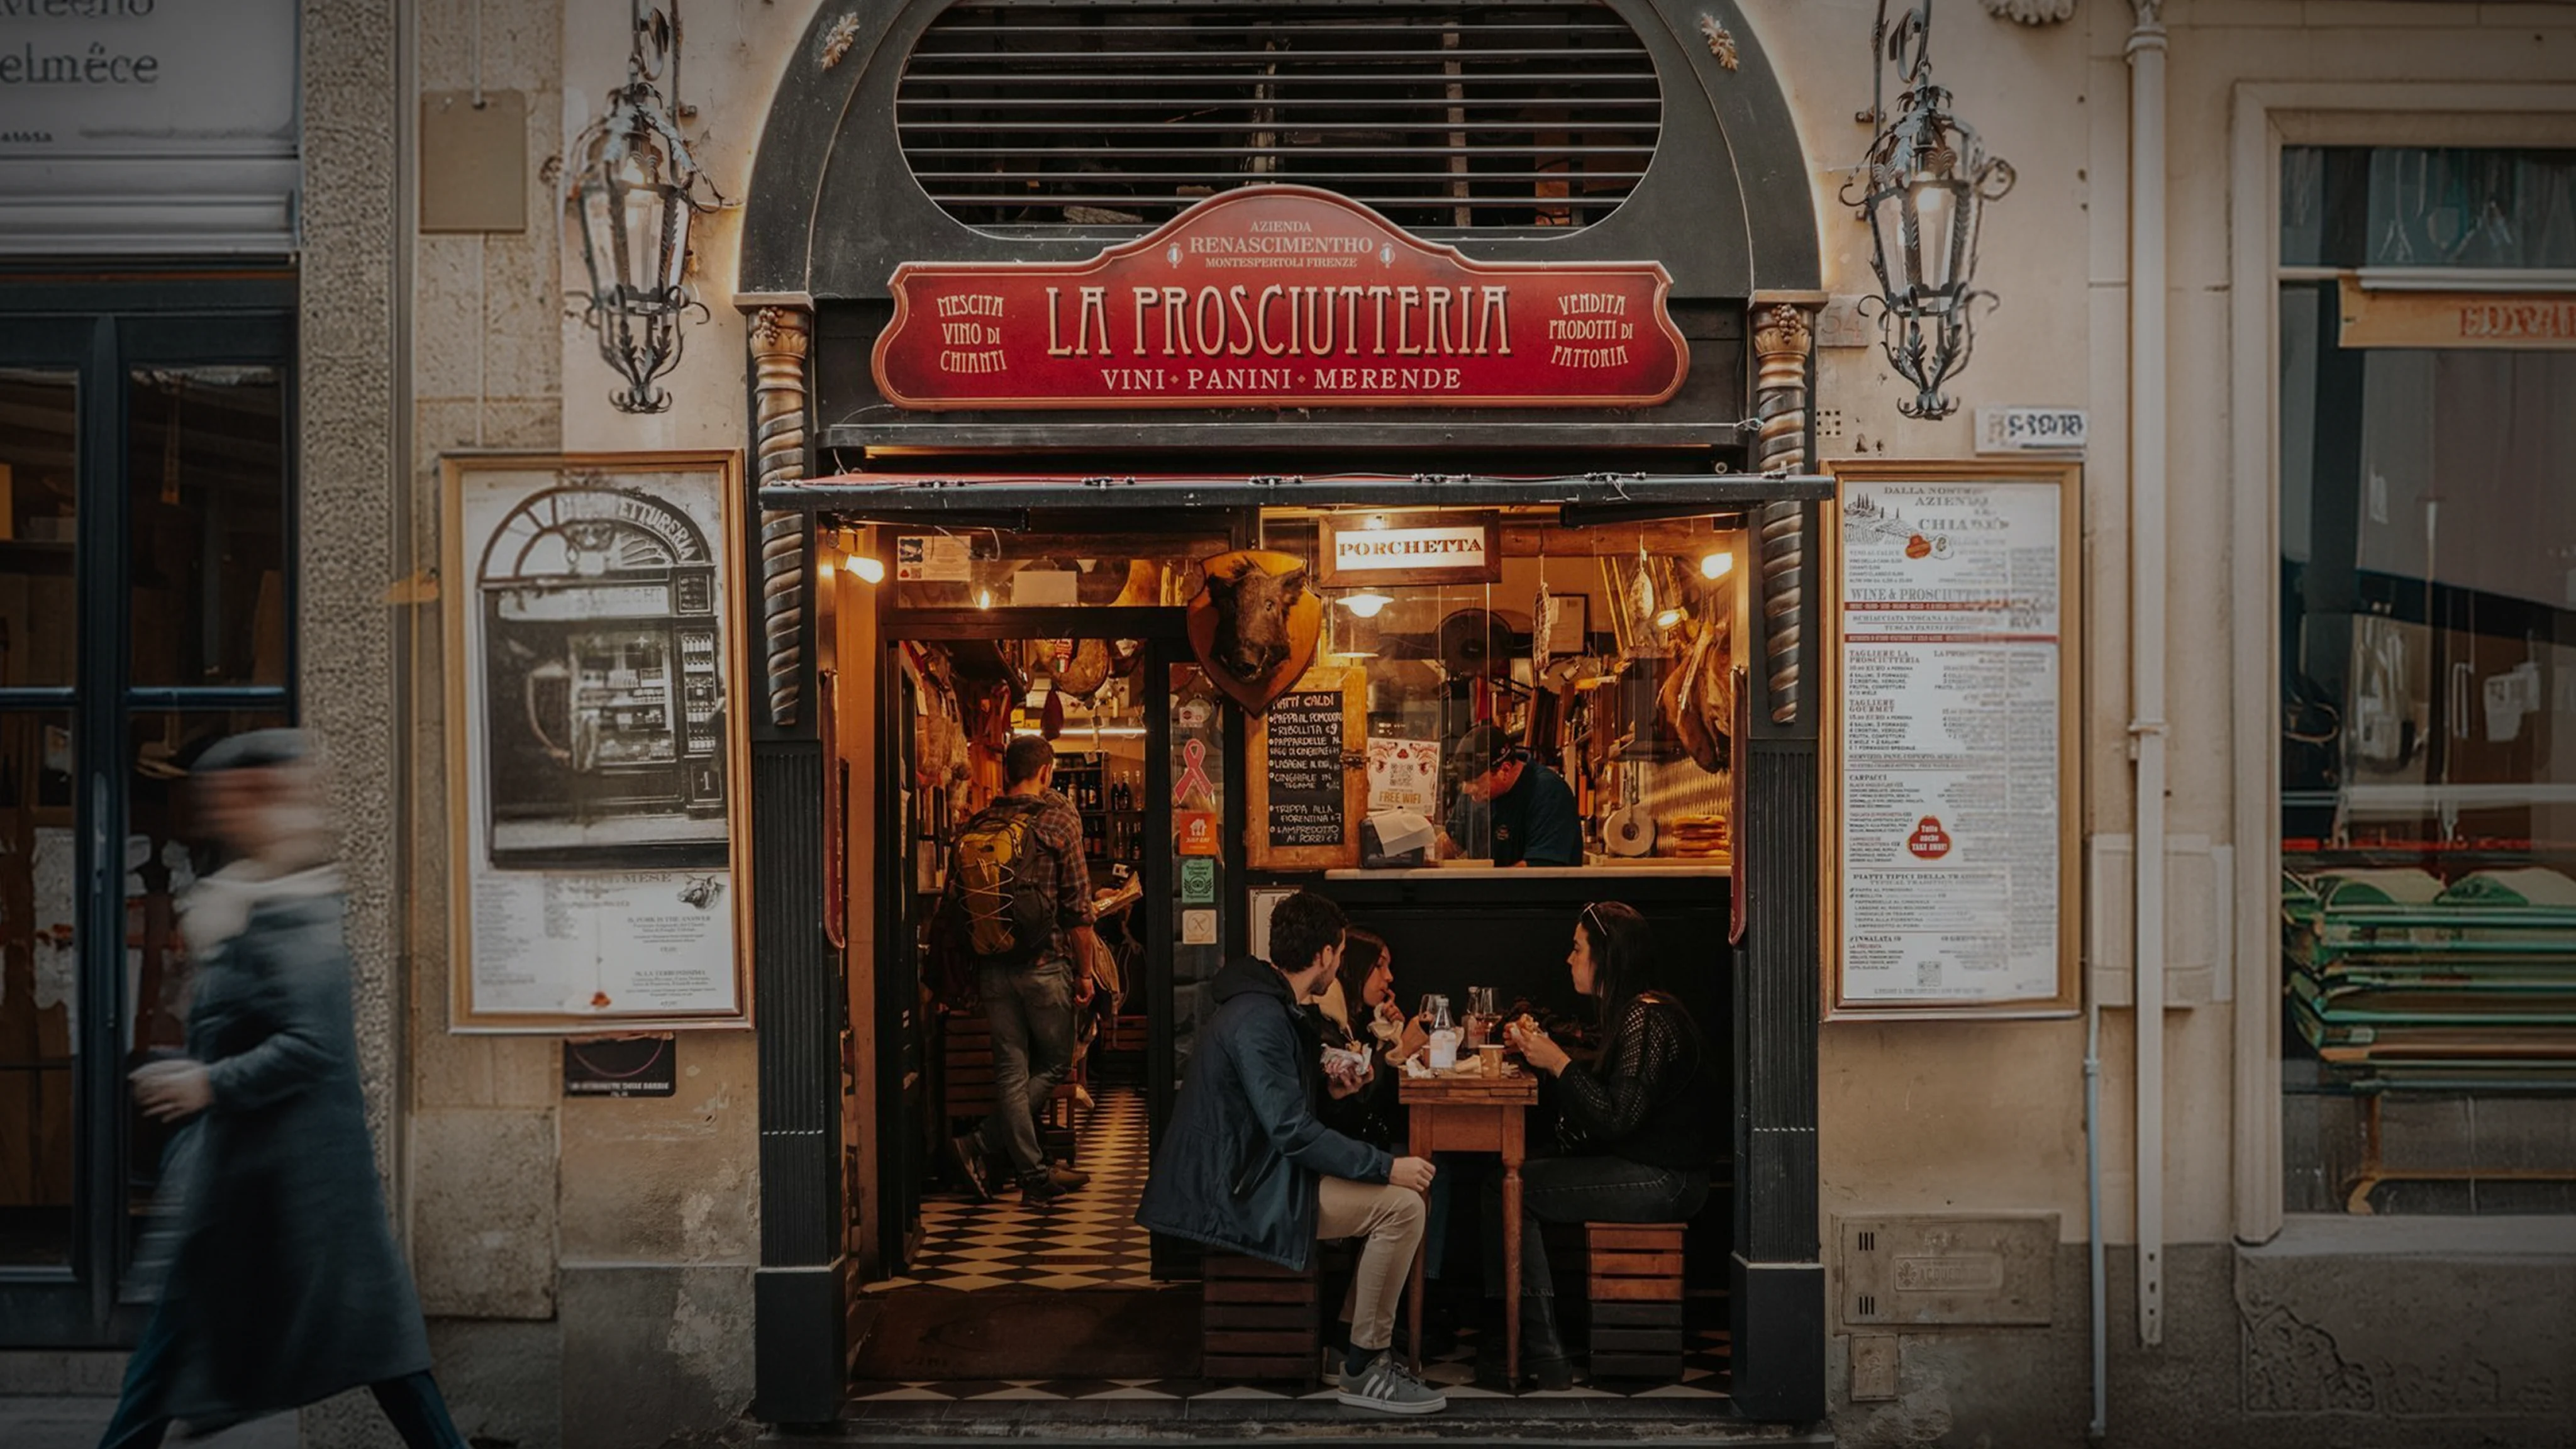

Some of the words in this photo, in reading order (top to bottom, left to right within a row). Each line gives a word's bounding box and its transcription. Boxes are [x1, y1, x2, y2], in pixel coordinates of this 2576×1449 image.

[1250, 221, 1312, 233] AZIENDA
[1190, 236, 1374, 253] RENASCIMENTHO
[1205, 257, 1303, 268] MONTESPERTOLI
[1306, 257, 1358, 268] FIRENZE
[936, 294, 1004, 318] MESCITA
[1558, 293, 1626, 316] VENDITA
[1046, 286, 1112, 356] LA
[1133, 284, 1512, 357] PROSCIUTTERIA
[1548, 319, 1617, 340] PRODOTTI
[1621, 323, 1633, 340] DI
[941, 323, 982, 345] VINO
[987, 327, 1001, 345] DI
[940, 349, 1008, 374] CHIANTI
[1550, 345, 1629, 369] FATTORIA
[1101, 369, 1165, 390] VINI
[1187, 368, 1292, 390] PANINI
[1313, 368, 1462, 390] MERENDE
[1338, 538, 1484, 557] PORCHETTA
[1851, 588, 1886, 600] WINE
[1889, 589, 1896, 600] &
[1278, 725, 1322, 735] RIBOLLITA
[1274, 736, 1327, 747] PAPPARDELLE
[1379, 791, 1401, 802] FREE
[1402, 793, 1421, 804] WIFI
[1275, 804, 1307, 814] TRIPPA
[1313, 805, 1333, 814] ALLA
[1280, 814, 1329, 823] FIORENTINA
